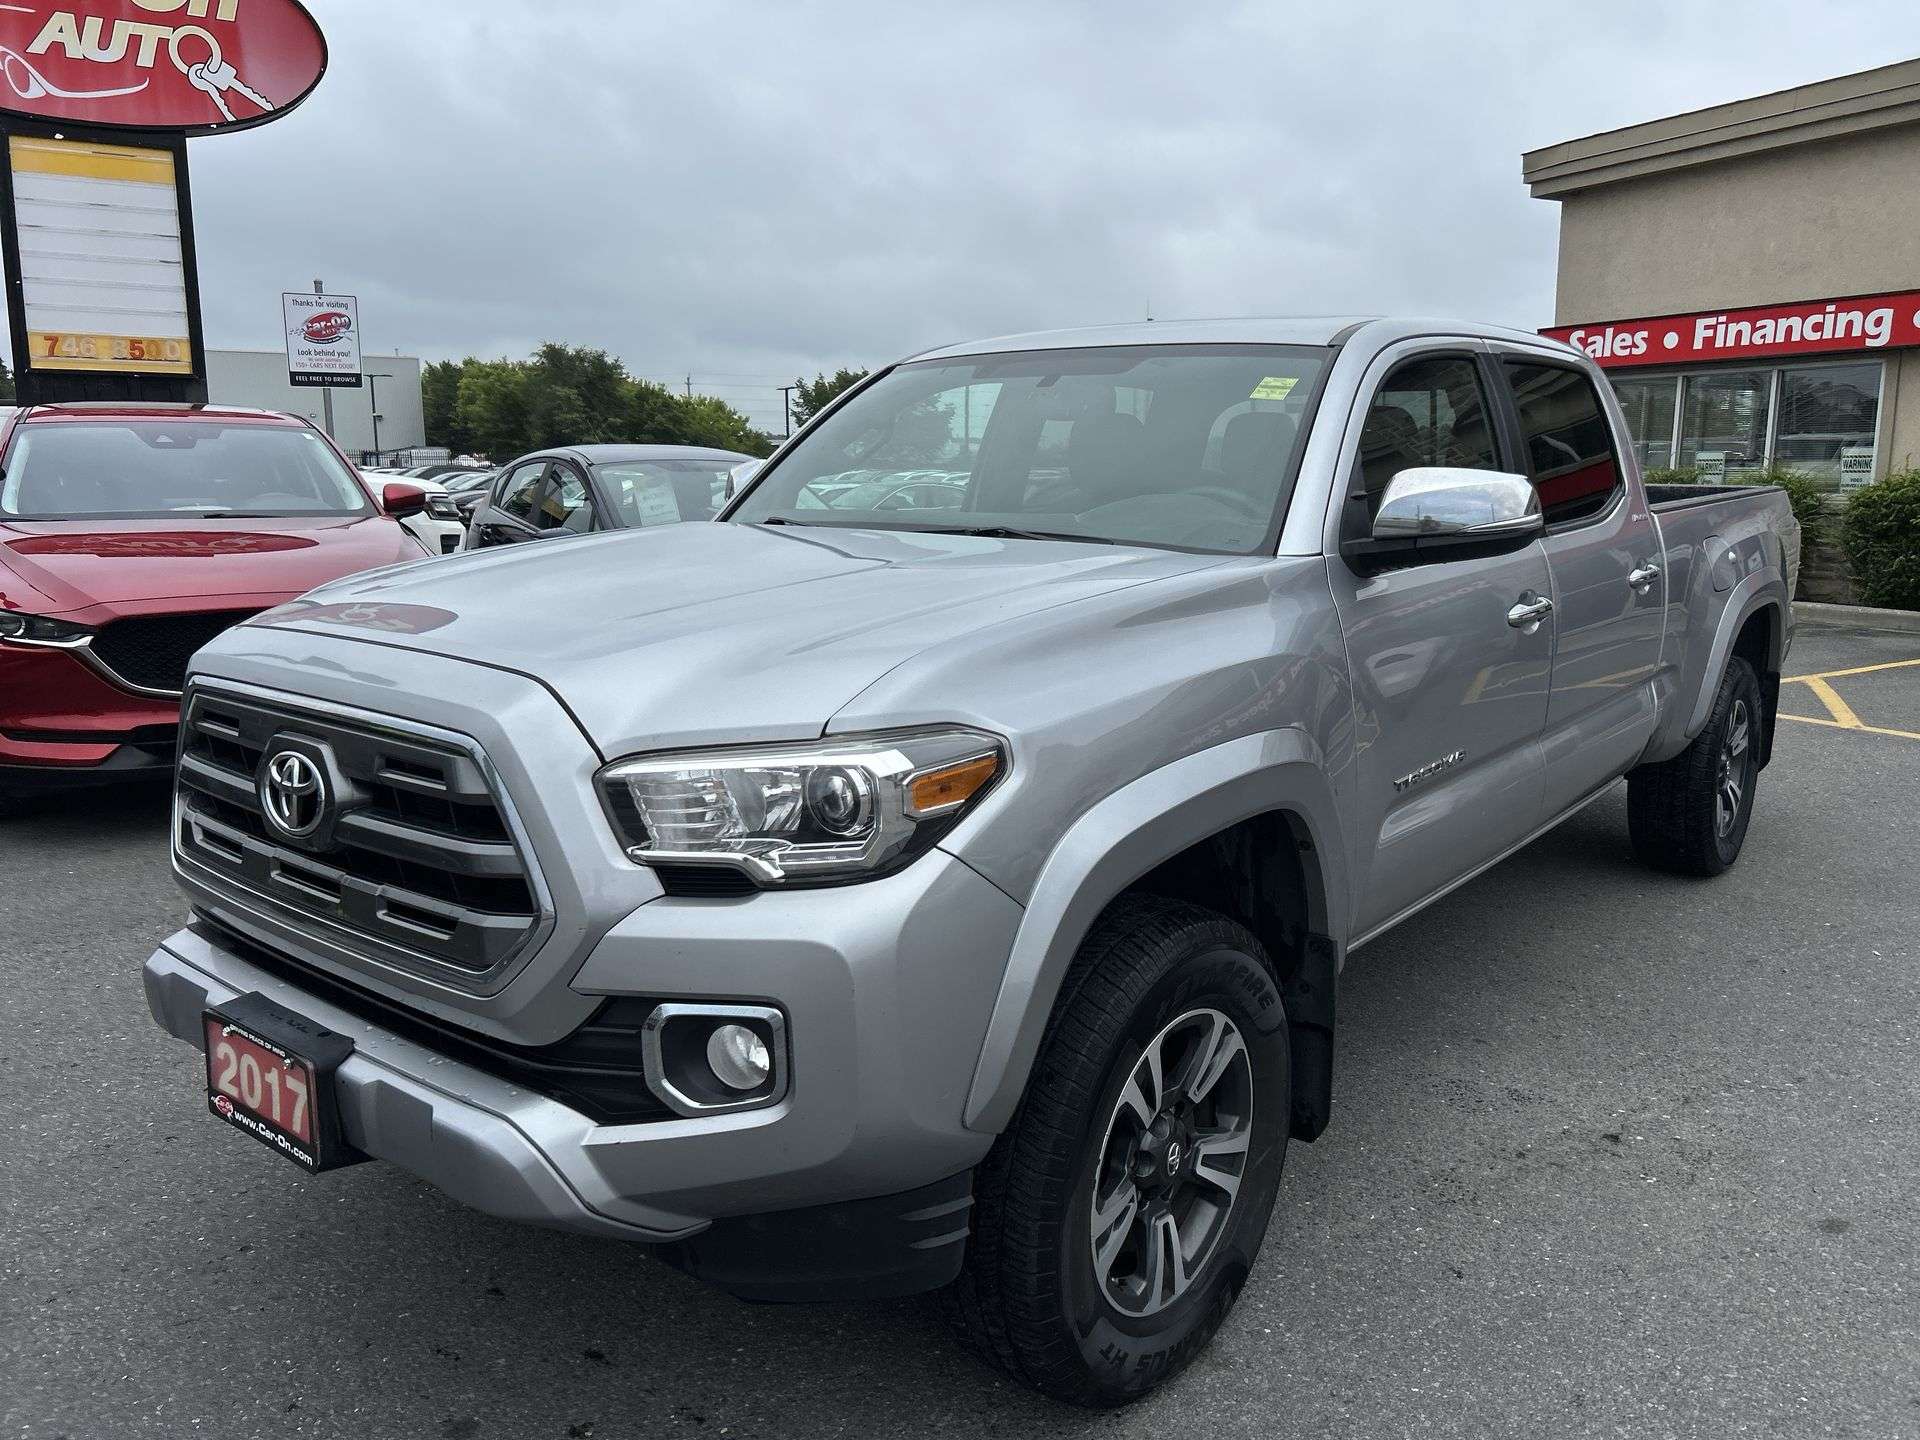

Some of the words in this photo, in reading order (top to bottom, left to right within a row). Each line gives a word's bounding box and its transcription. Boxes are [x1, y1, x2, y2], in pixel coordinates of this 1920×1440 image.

[26, 11, 222, 77] AUTO
[292, 299, 314, 307] Thanks
[315, 300, 325, 308] for
[326, 301, 349, 310] visiting
[1569, 327, 1649, 359] Sales
[1692, 304, 1894, 350] Financing
[297, 348, 312, 356] Look
[314, 348, 335, 357] behind
[337, 350, 351, 358] you!
[216, 1042, 307, 1134] 2017
[234, 1110, 313, 1167] www.Car-On.com
